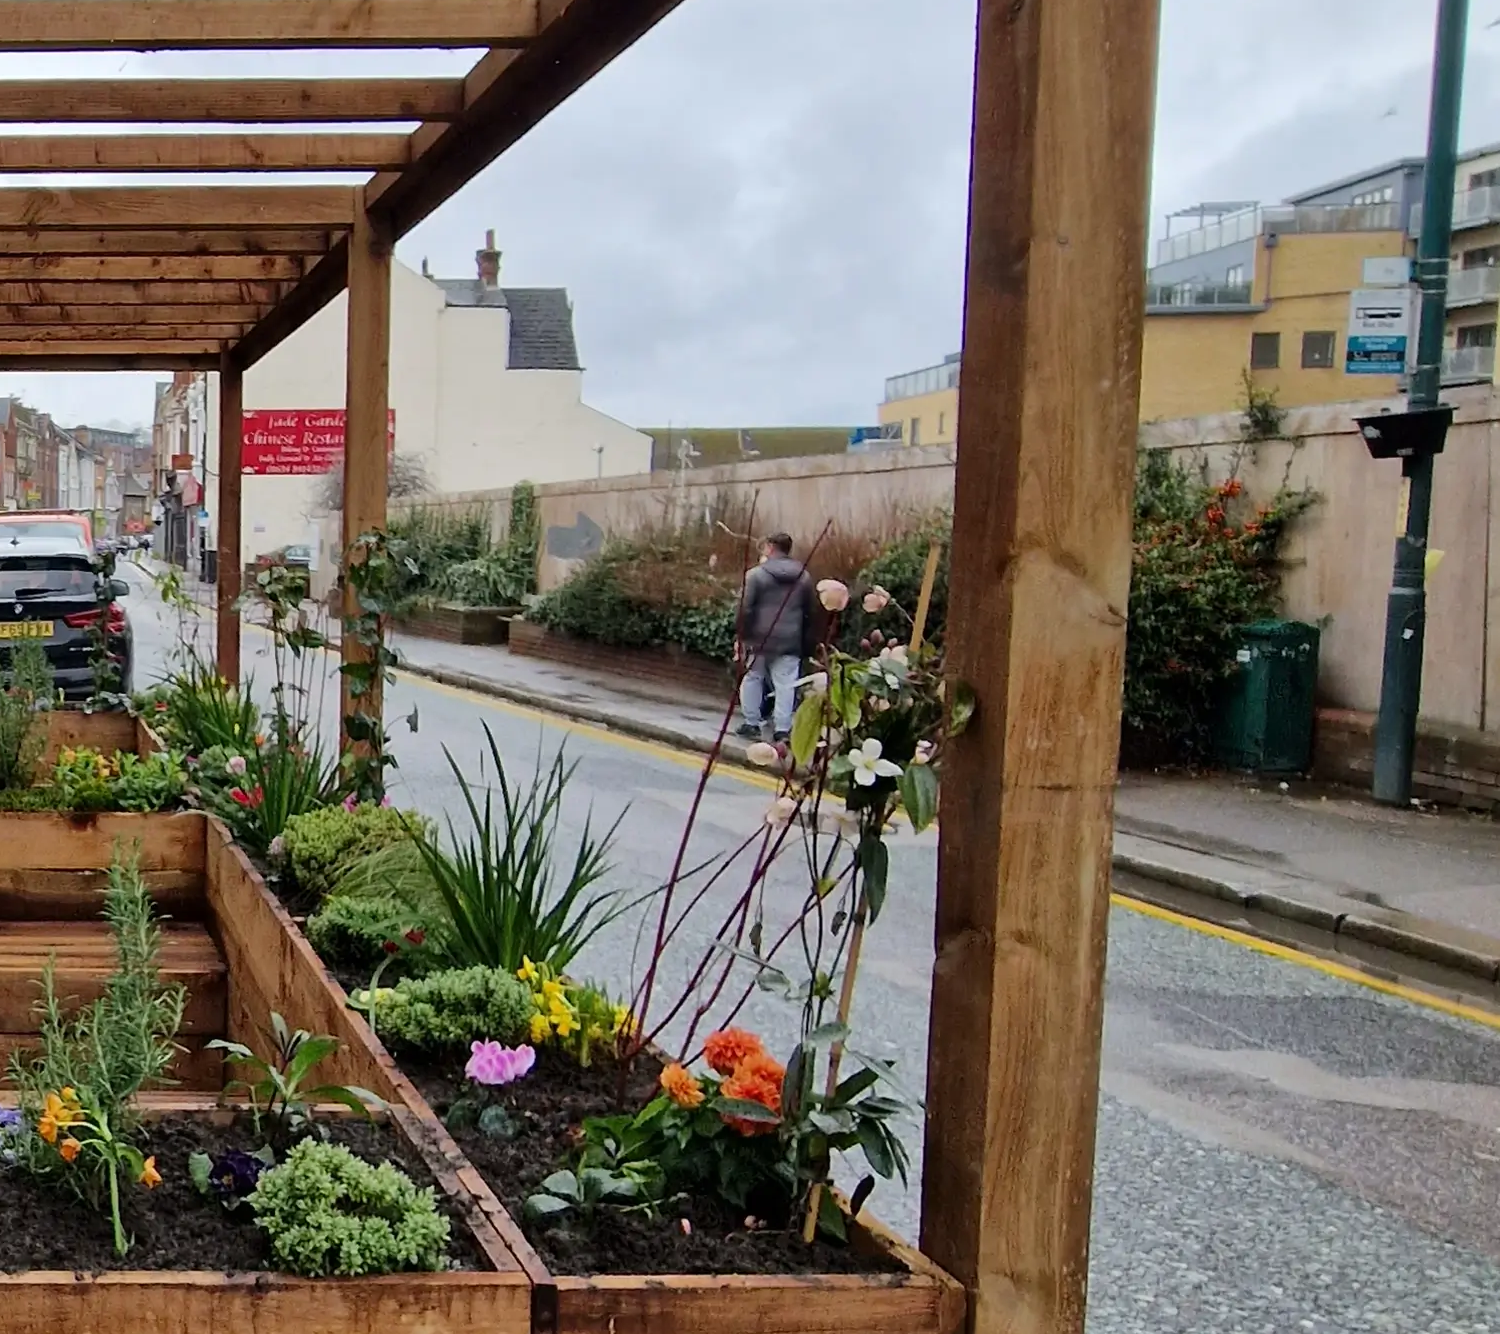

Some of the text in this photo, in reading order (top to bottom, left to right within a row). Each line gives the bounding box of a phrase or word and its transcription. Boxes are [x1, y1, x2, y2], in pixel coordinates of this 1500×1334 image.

[268, 413, 346, 429] Jade Garde
[243, 430, 297, 445] Chinese
